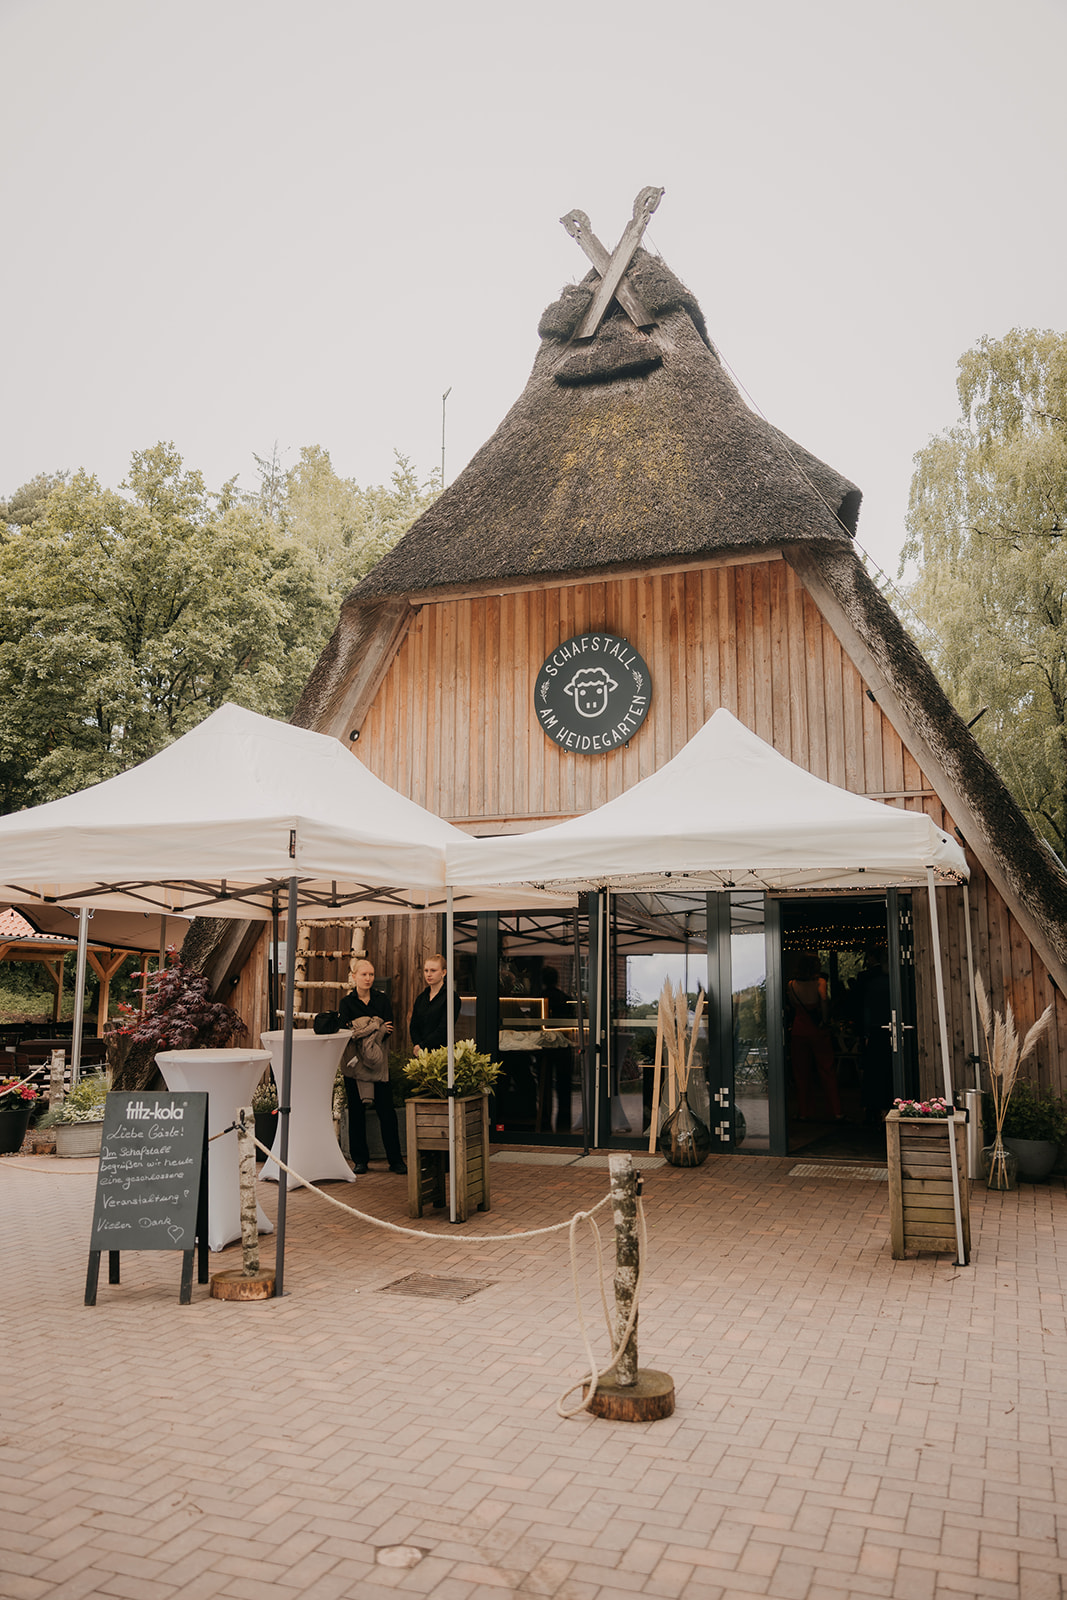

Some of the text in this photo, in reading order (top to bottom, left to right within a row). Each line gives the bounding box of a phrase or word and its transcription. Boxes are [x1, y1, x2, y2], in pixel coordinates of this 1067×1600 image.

[545, 636, 636, 676] SCHAFSTALL
[540, 695, 647, 750] AM HEIDEGARTEN
[106, 1123, 184, 1140] Liebe Gäste!
[102, 1145, 171, 1160] Im Schafstall
[100, 1156, 194, 1174] begrüßen wir heute
[99, 1175, 123, 1185] eine
[97, 1216, 172, 1232] Vielen Dank
